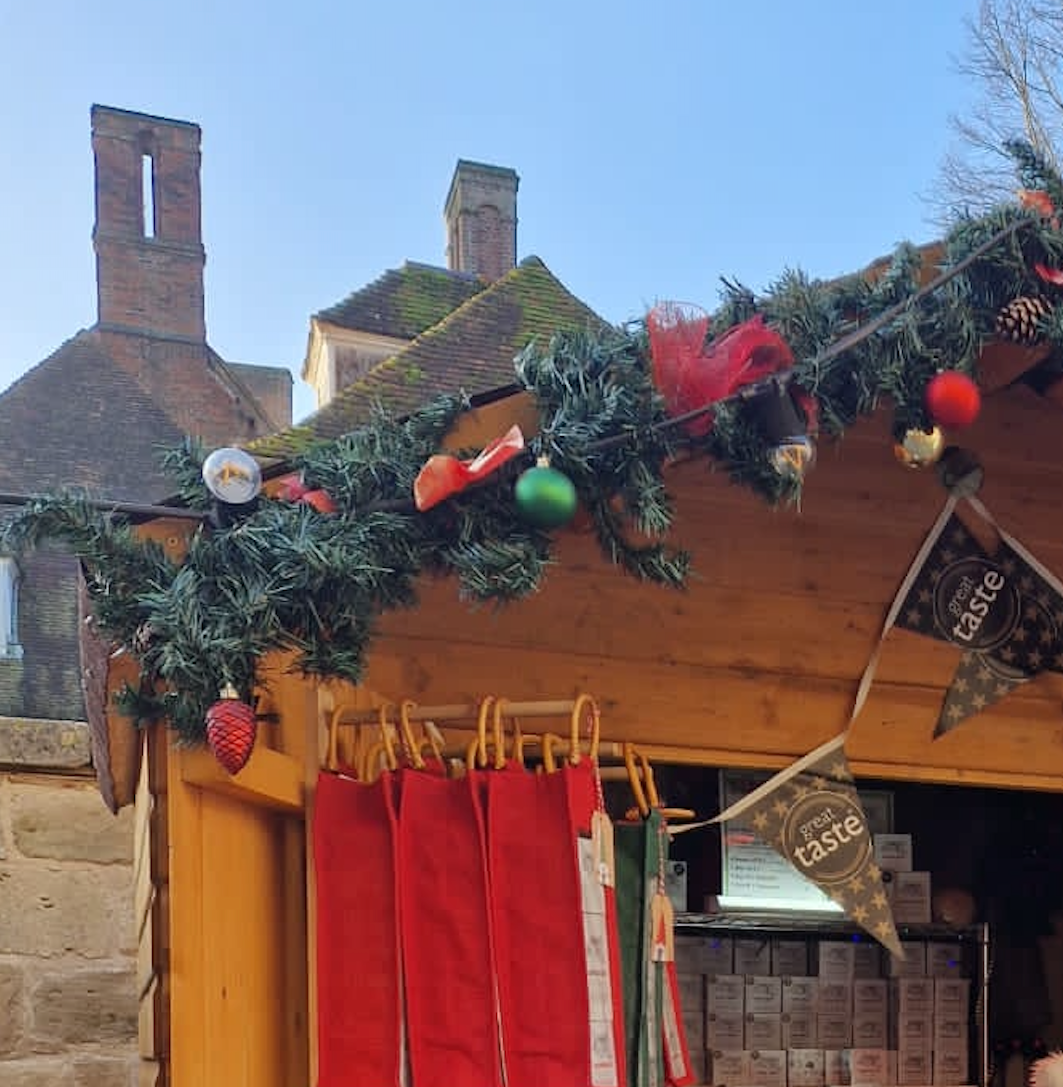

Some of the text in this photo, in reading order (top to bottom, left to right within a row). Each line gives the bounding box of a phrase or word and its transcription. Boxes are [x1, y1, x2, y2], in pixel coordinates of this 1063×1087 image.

[948, 576, 976, 616] great
[953, 570, 1005, 641] taste
[793, 814, 865, 867] taste
[800, 808, 837, 840] great
